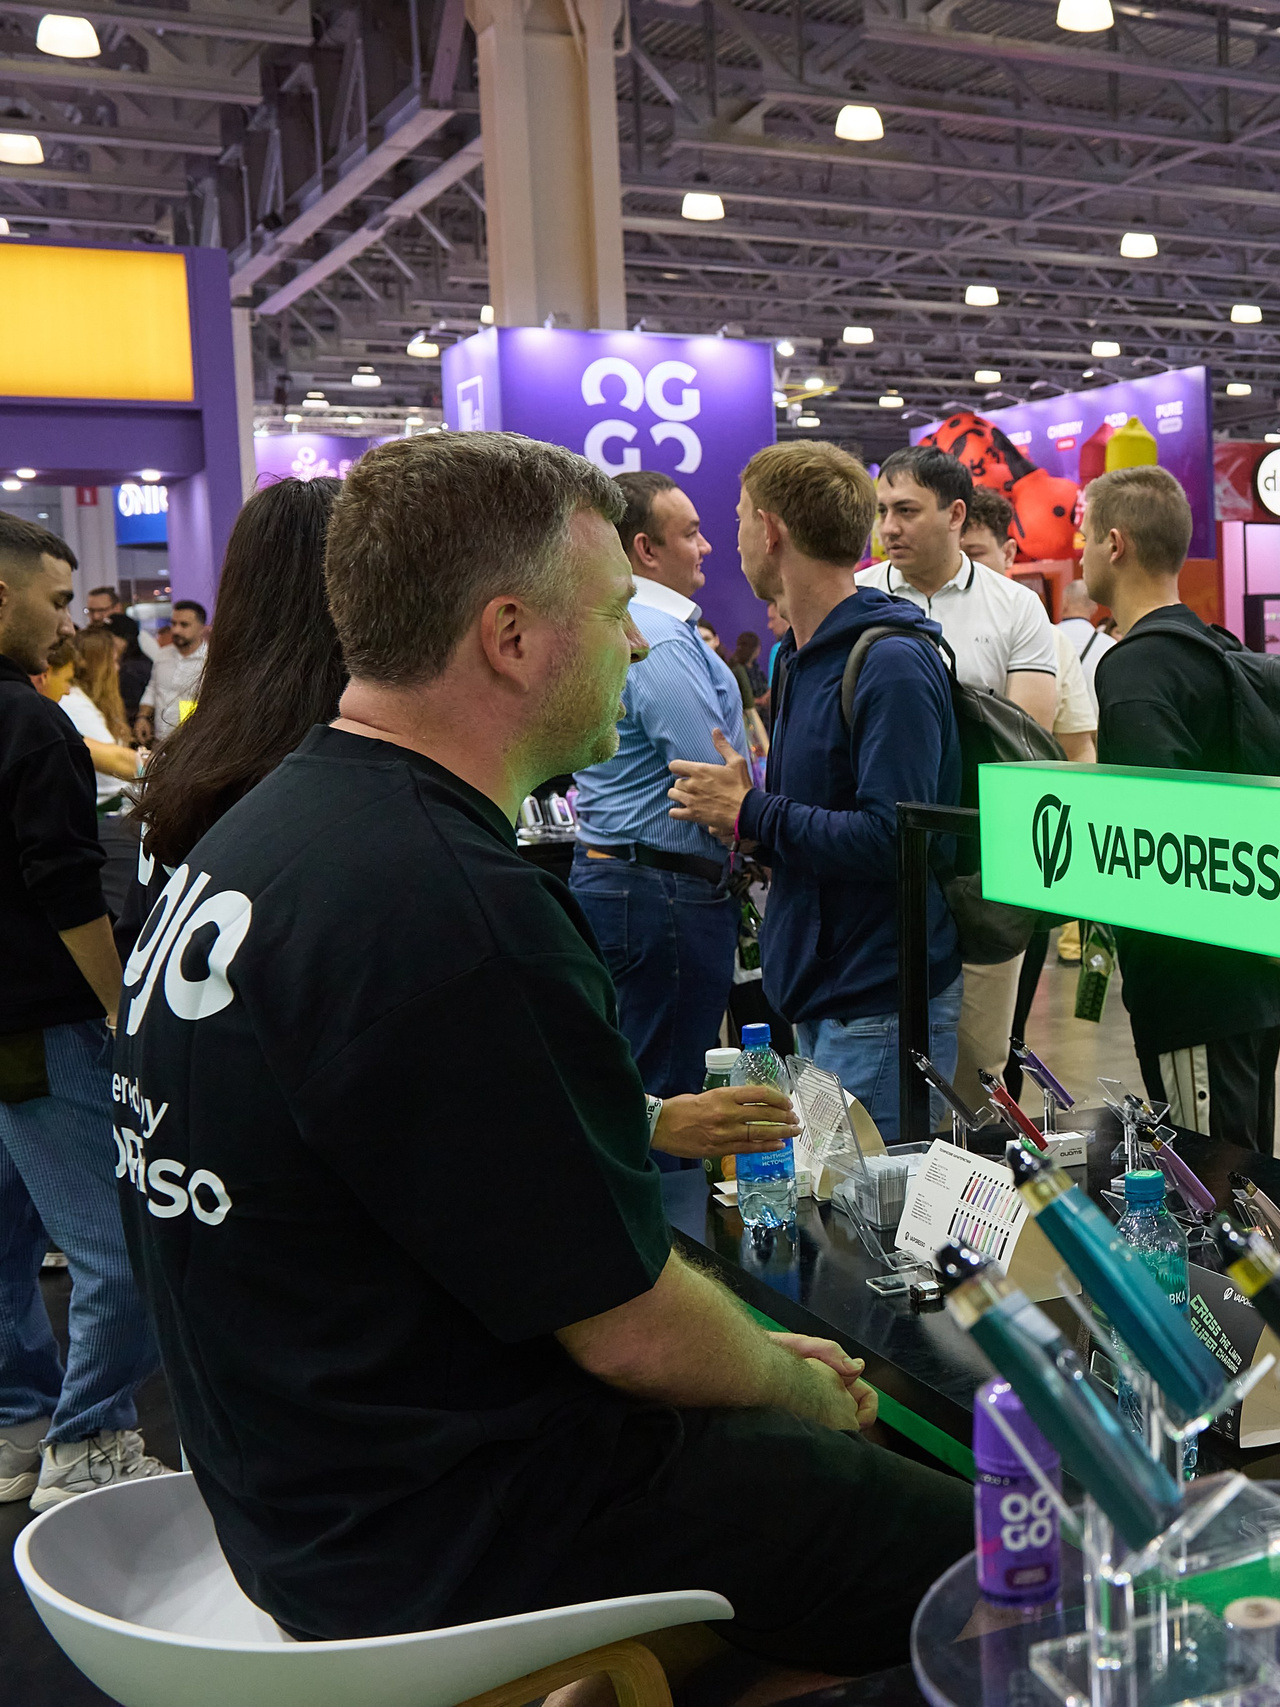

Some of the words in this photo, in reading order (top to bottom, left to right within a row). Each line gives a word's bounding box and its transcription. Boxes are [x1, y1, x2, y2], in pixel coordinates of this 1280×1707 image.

[124, 863, 253, 1036] ojo
[1189, 1293, 1222, 1337] CROSS
[1221, 1332, 1231, 1350] THE
